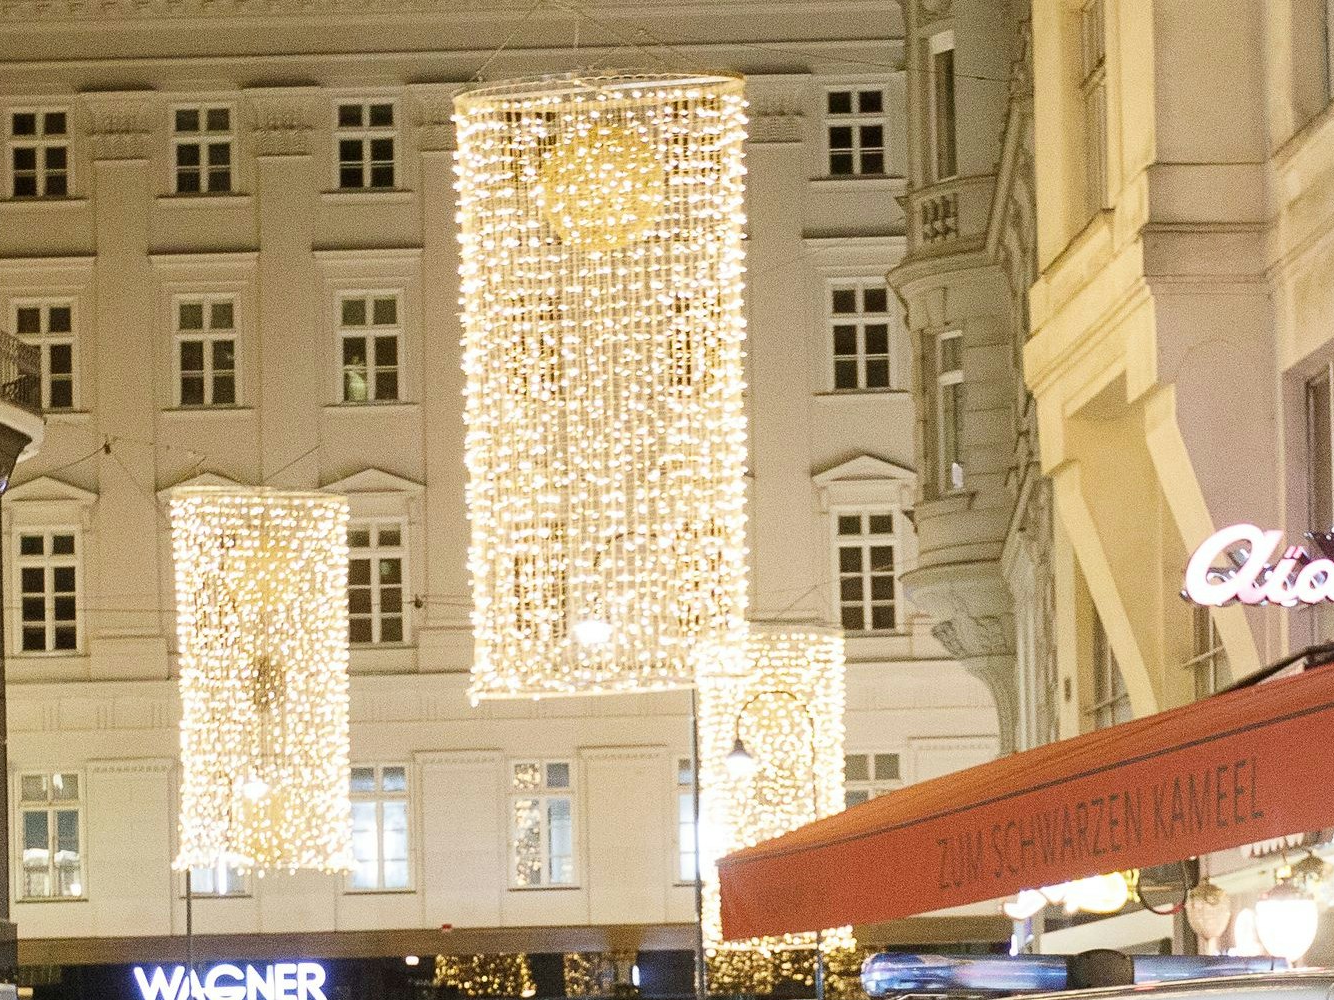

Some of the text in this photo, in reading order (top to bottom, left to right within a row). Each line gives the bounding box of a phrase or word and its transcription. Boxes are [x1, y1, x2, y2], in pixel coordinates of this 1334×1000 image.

[937, 757, 1265, 890] ZUM SCHWARZEN KAMEEL
